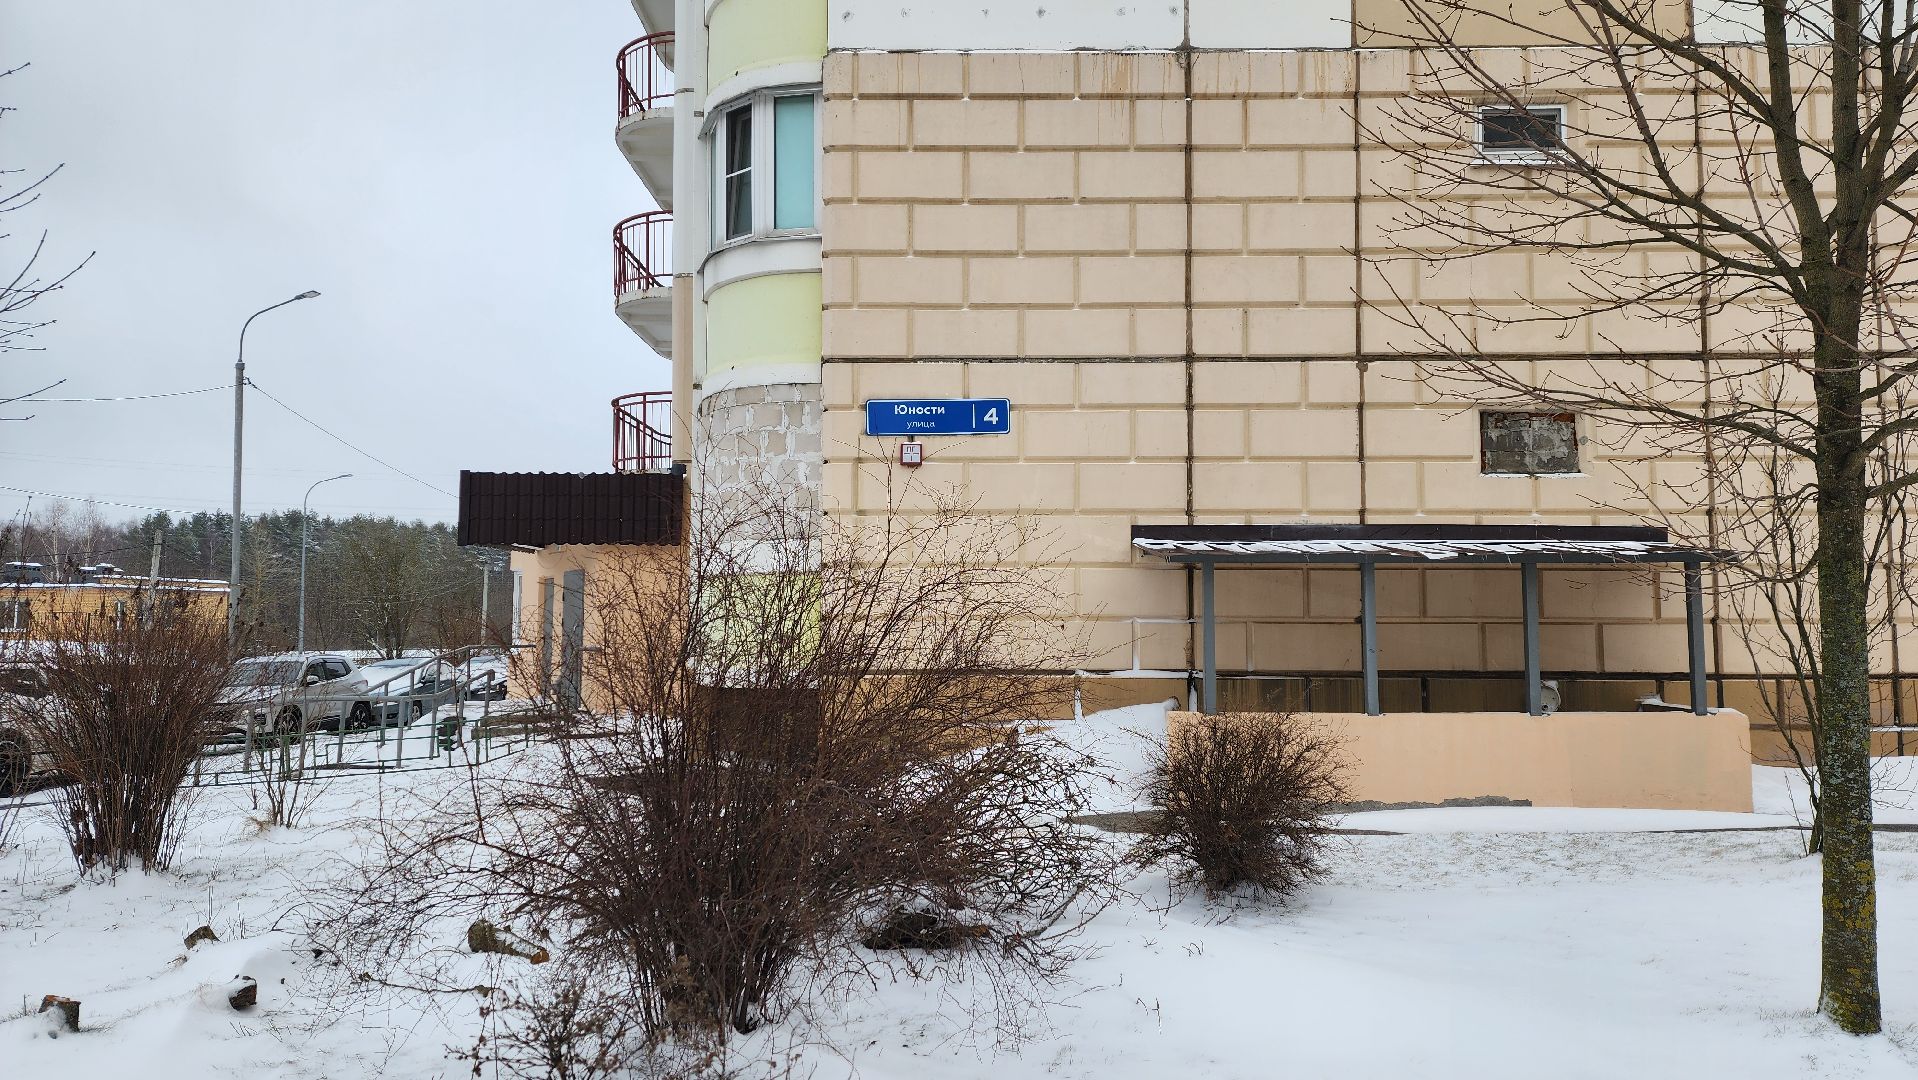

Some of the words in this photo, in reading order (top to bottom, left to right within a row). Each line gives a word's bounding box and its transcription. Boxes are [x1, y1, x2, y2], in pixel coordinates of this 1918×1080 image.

[894, 404, 945, 415] Юности
[983, 407, 999, 425] 4
[906, 421, 936, 430] улица
